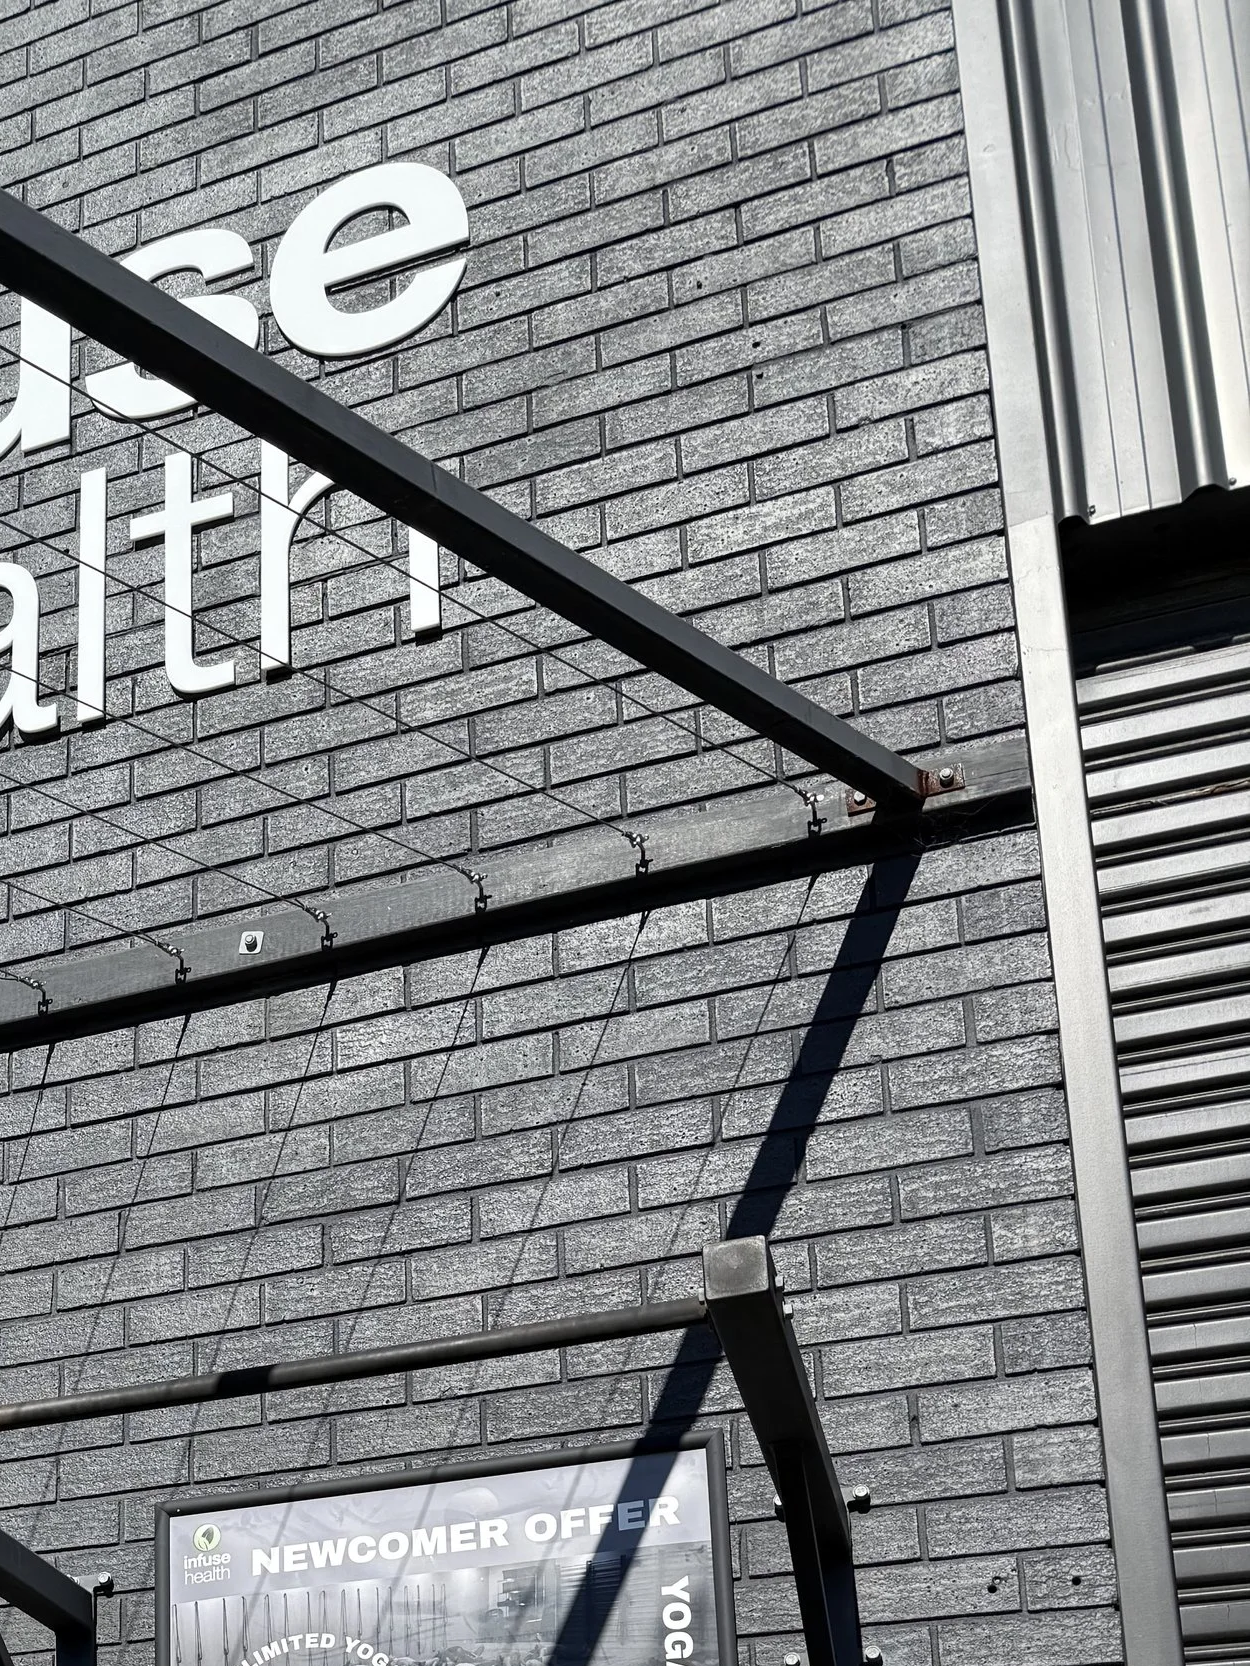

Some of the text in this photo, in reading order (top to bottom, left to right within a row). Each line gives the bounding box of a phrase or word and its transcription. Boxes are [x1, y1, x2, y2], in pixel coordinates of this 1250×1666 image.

[251, 1496, 681, 1576] NEWCOMER OFFER
[183, 1549, 232, 1568] infuse
[184, 1566, 231, 1585] health
